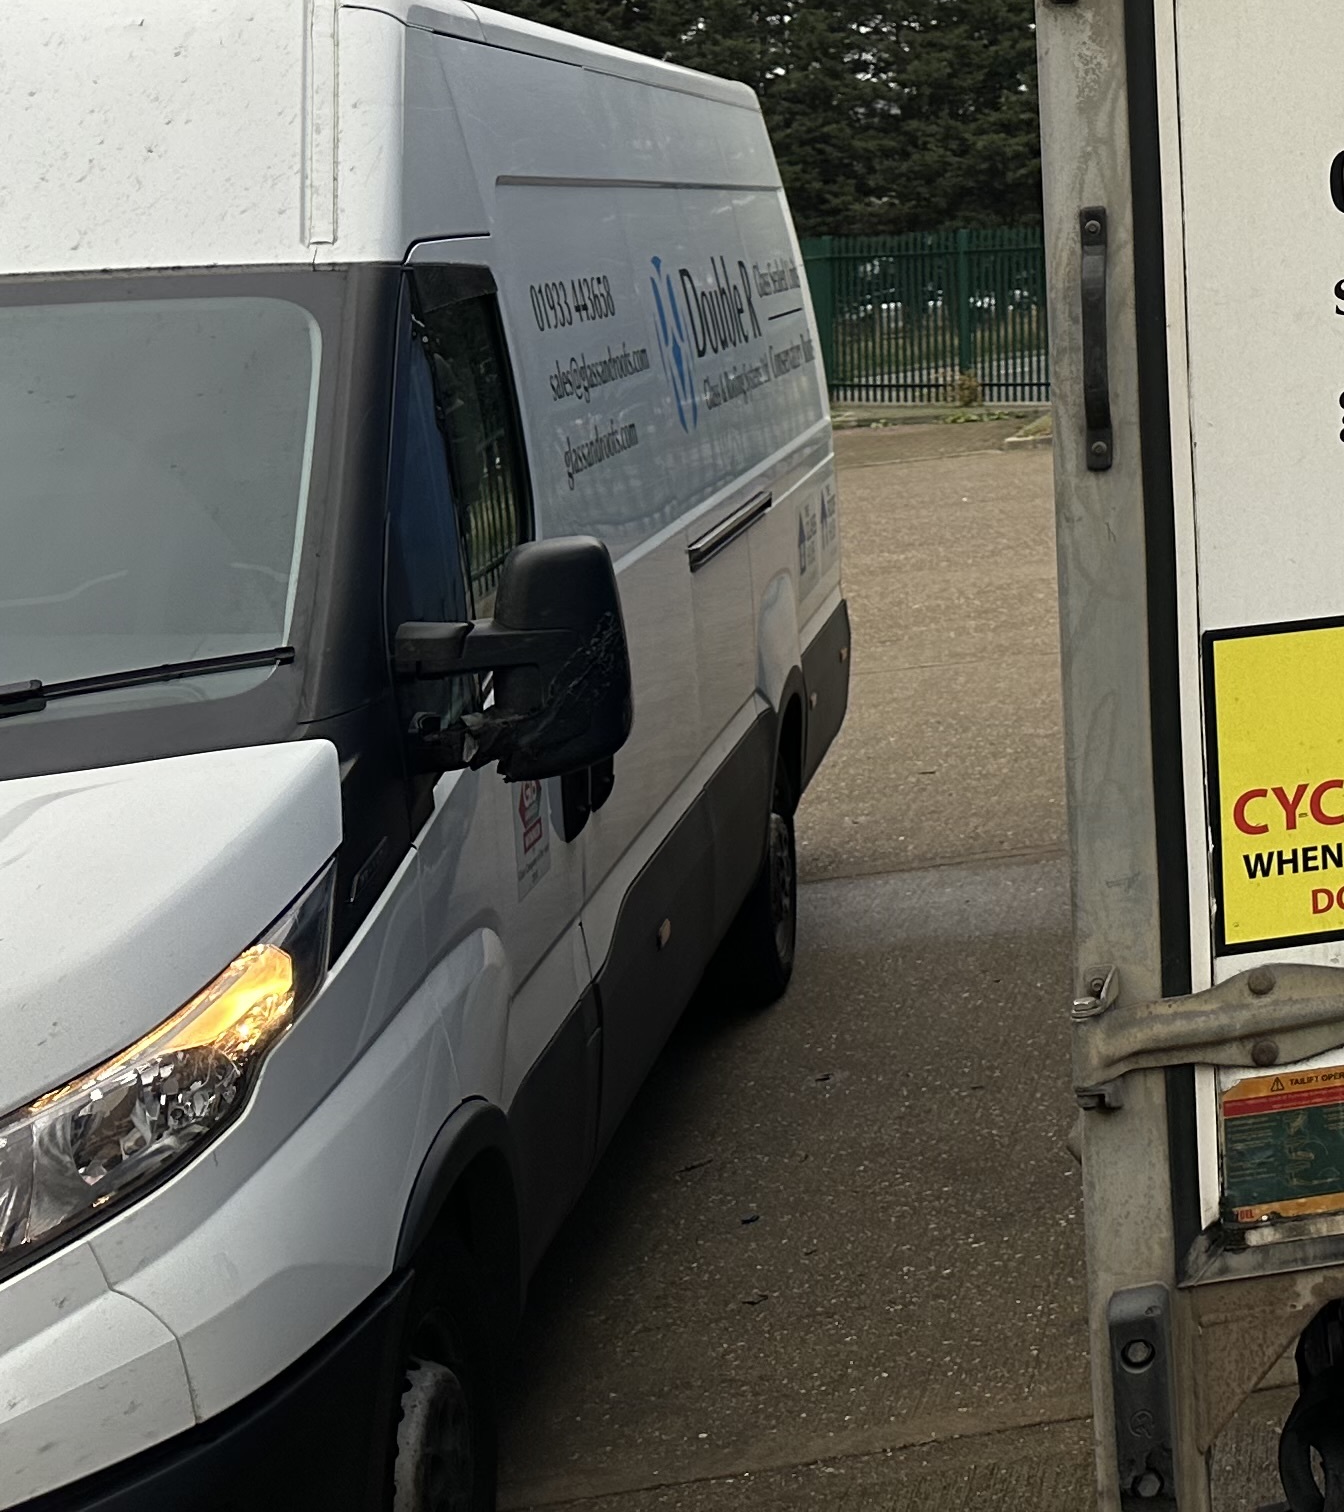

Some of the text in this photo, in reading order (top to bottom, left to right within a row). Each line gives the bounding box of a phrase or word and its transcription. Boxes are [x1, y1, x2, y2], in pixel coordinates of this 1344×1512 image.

[530, 275, 616, 332] 01933 443658
[678, 255, 750, 358] Double
[1243, 840, 1344, 880] WHEN
